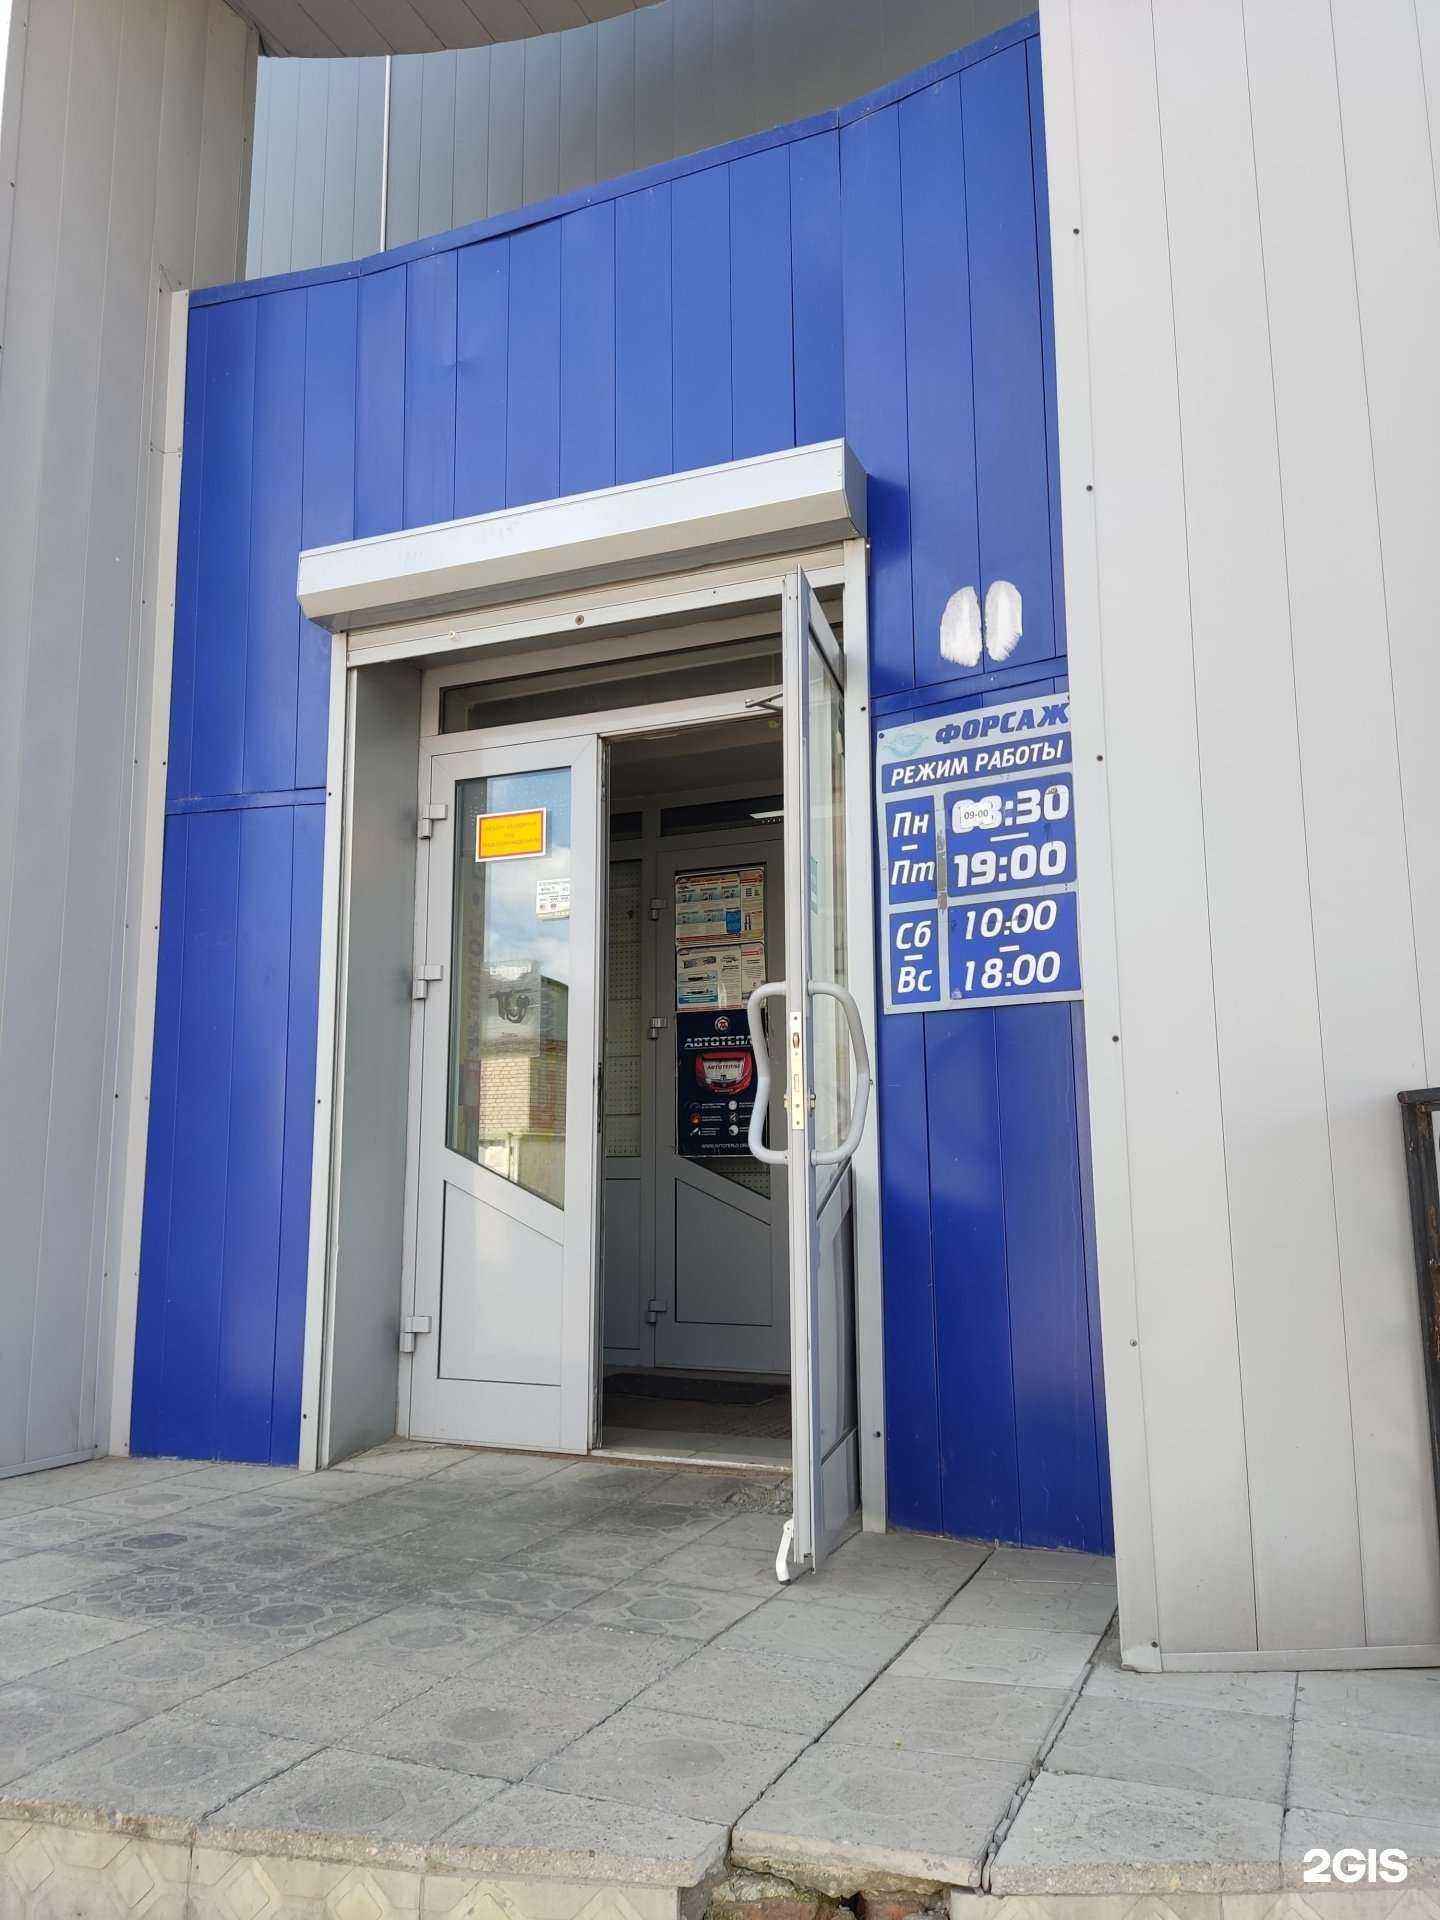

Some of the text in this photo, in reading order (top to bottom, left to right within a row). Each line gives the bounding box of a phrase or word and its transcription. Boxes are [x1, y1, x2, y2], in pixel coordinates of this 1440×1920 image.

[935, 703, 1070, 744] ФОРСАЖ
[891, 740, 1063, 786] РЕЖИМ РАБОТЫ
[892, 812, 929, 837] Пн
[891, 859, 935, 885] Пт
[953, 840, 1067, 888] 19:00
[896, 920, 932, 950] Сб
[965, 900, 1058, 940] 10:00
[897, 966, 933, 993] Вс
[965, 951, 1061, 992] 18:00
